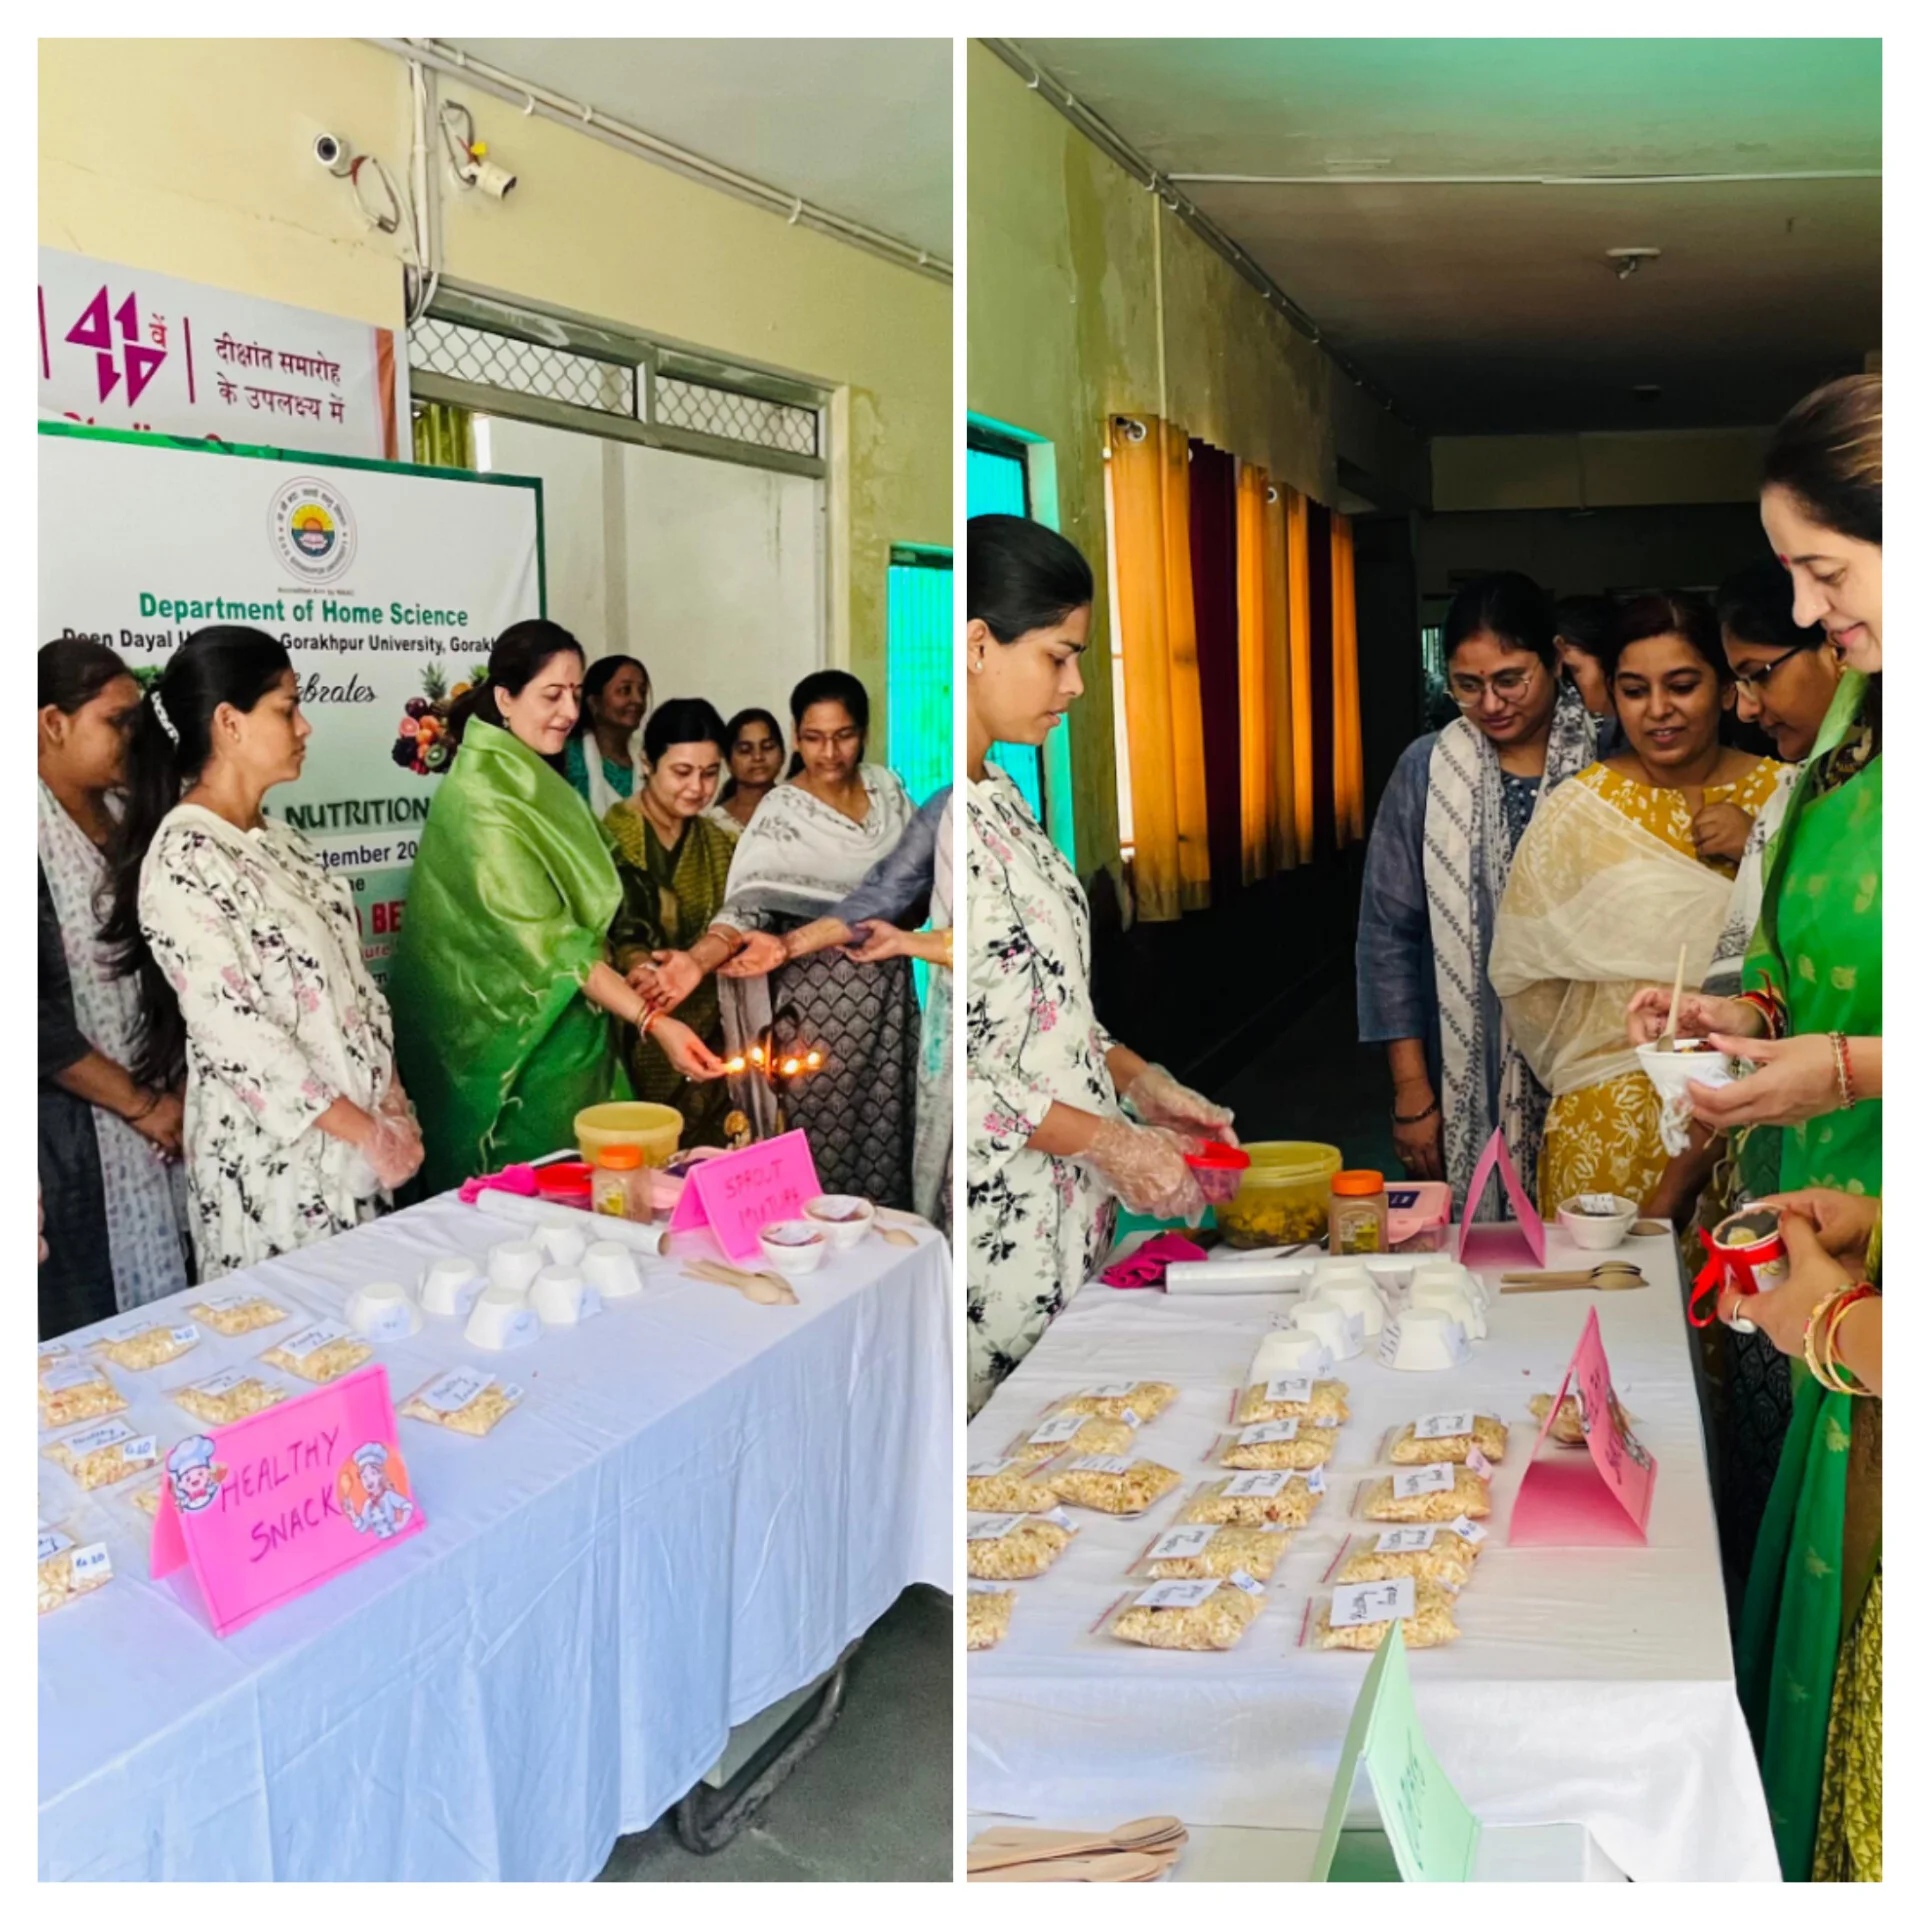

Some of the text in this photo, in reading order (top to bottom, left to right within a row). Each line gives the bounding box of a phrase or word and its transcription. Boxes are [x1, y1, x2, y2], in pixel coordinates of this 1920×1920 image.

[214, 332, 341, 386] दीक्षांत समारोह
[217, 371, 345, 424] के उपलक्ष्य में
[139, 592, 469, 627] Department of Home Science
[120, 629, 172, 652] Dayal
[280, 632, 365, 654] Gorakhpur
[368, 635, 446, 656] University,
[450, 636, 496, 653] Gorak
[285, 796, 431, 830] NUTRITION
[316, 845, 391, 868] tember
[219, 1425, 341, 1513] HEALTHY
[250, 1486, 343, 1563] SNACK
